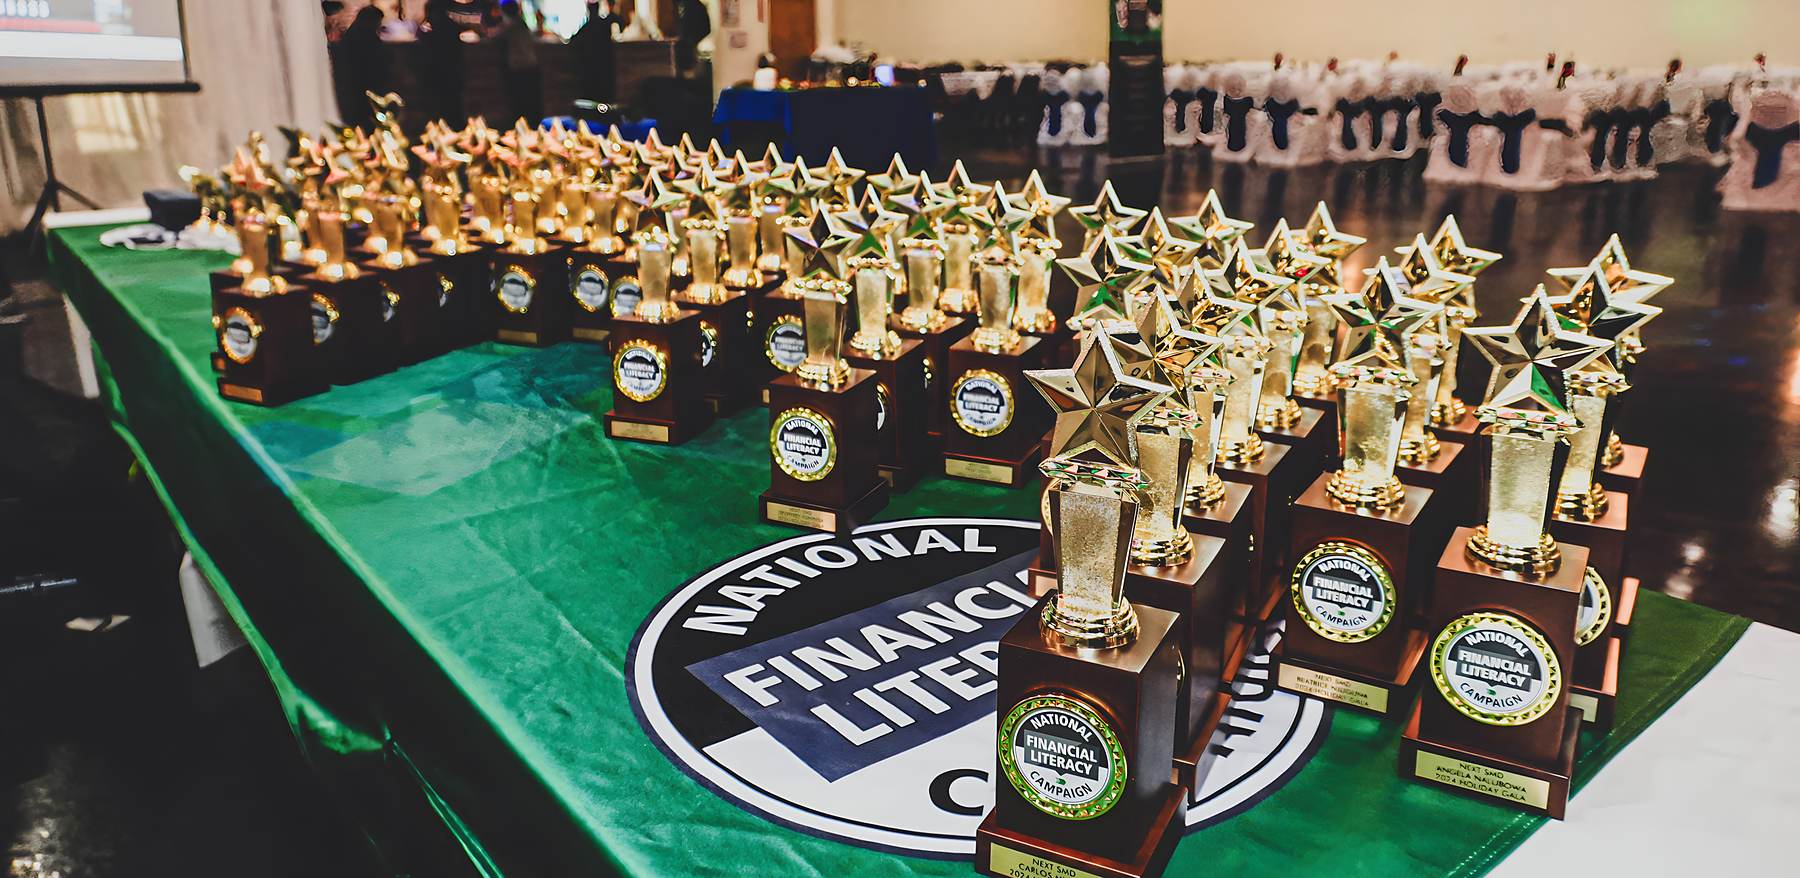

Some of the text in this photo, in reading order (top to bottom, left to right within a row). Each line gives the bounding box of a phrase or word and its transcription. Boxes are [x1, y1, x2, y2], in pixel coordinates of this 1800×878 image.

[785, 420, 819, 435] NATIONAL
[783, 433, 822, 448] FINANCIAL
[786, 442, 820, 455] LITERACY
[682, 528, 997, 636] NATIONAL
[1318, 560, 1371, 582] NATIONAL
[1313, 576, 1373, 599] FINANCIAL
[1316, 588, 1370, 608] LITERACY
[1316, 605, 1368, 627] CAMPAIGN
[723, 569, 1038, 708] FINANCI
[1464, 631, 1529, 657] NATIONAL
[1458, 650, 1532, 677] FINANCIAL
[1461, 664, 1527, 688] LITERACY
[1460, 682, 1524, 708] CAMPAIGN
[1030, 713, 1093, 742] NATIONAL
[1026, 734, 1098, 763] FINANCIAL
[1030, 749, 1093, 775] LITERACY
[1460, 763, 1504, 780] NEXT SMD
[1030, 771, 1093, 799] CAMPAIGN
[1436, 766, 1471, 782] ANGELA
[1435, 773, 1526, 801] 2024 HOLIDAY GALA
[1018, 863, 1053, 878] CARLOS
[1032, 858, 1077, 877] NEXT SMD
